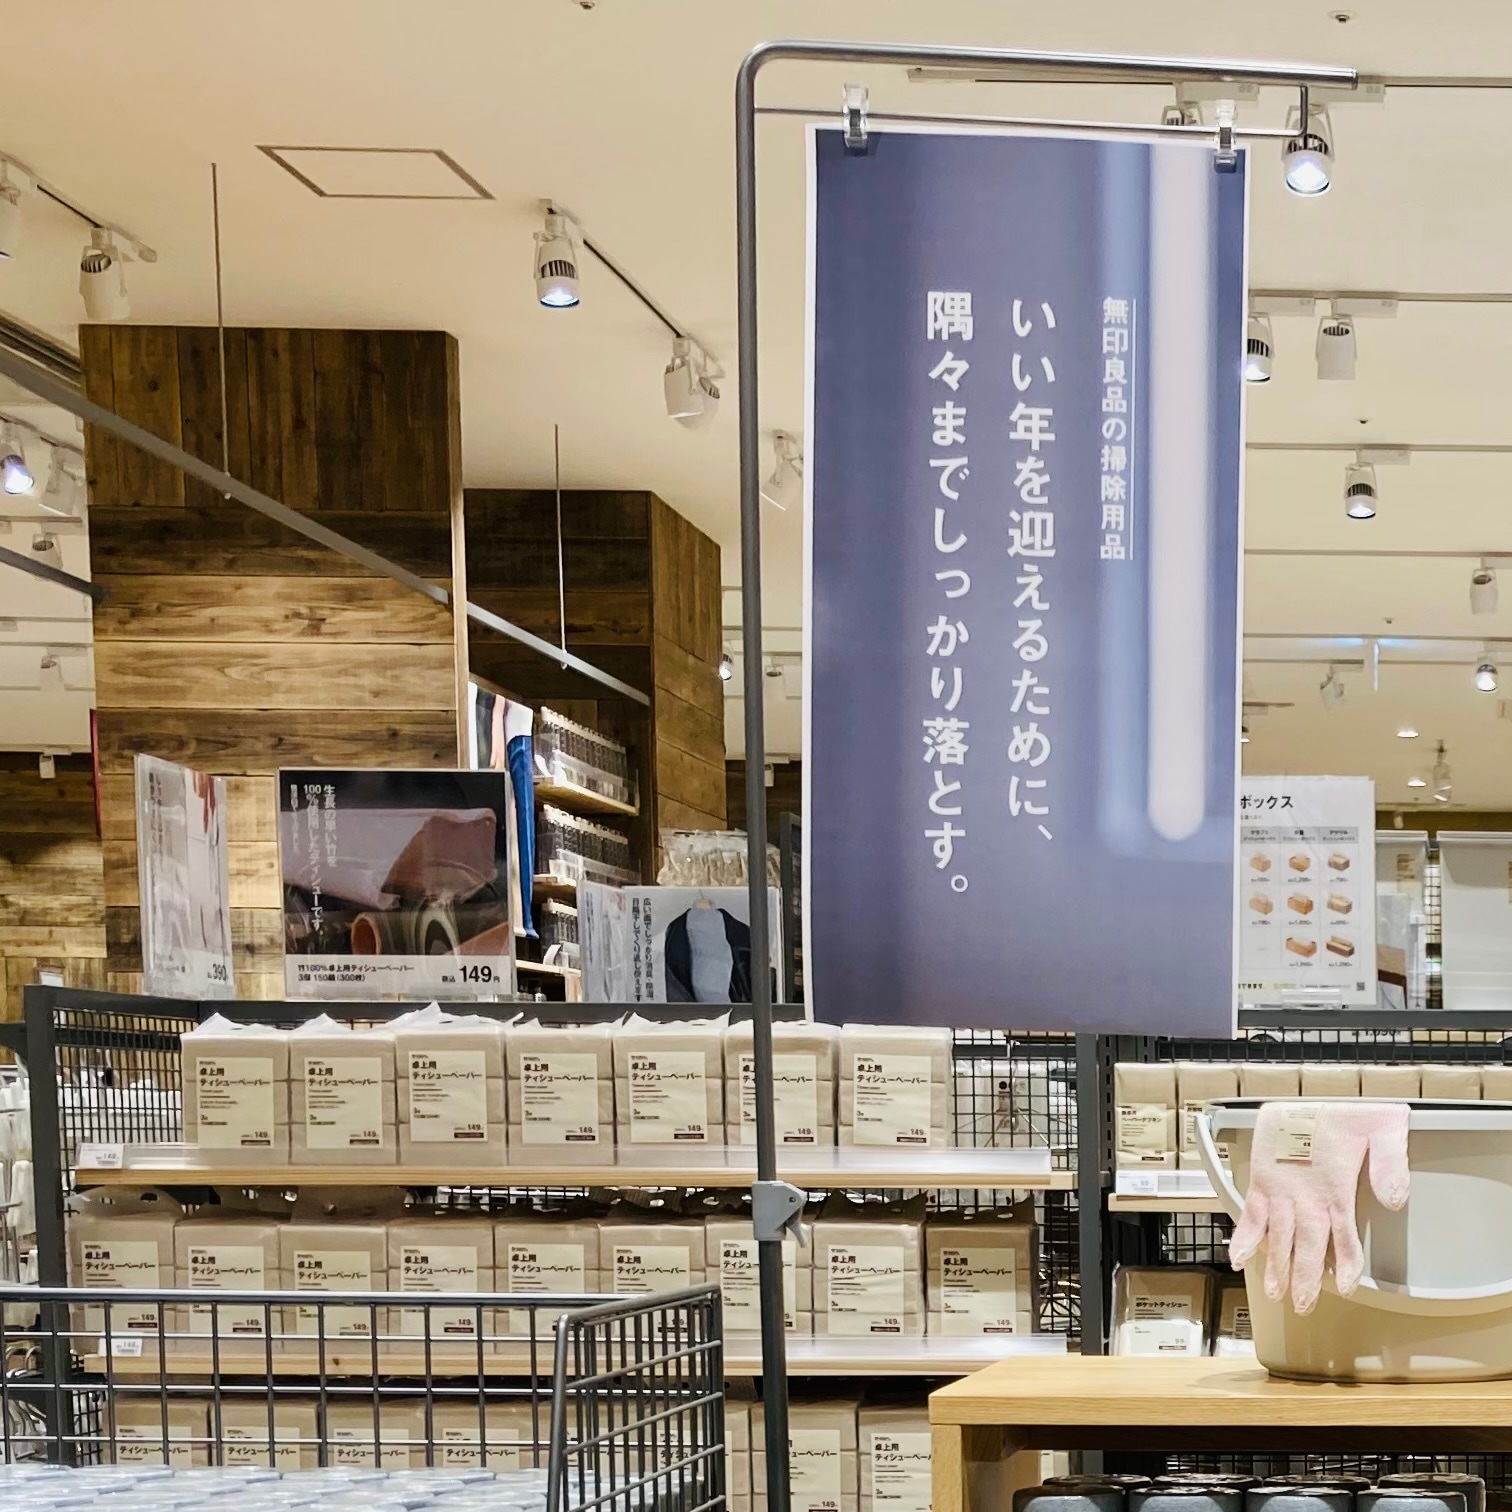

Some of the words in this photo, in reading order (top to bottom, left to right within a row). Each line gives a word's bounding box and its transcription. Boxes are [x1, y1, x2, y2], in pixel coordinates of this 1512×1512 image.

[922, 291, 974, 893] 隅々までしっかり落とす。
[1007, 299, 1056, 841] いい年を迎えるために、
[1100, 297, 1129, 561] 無印良品の掃除用品
